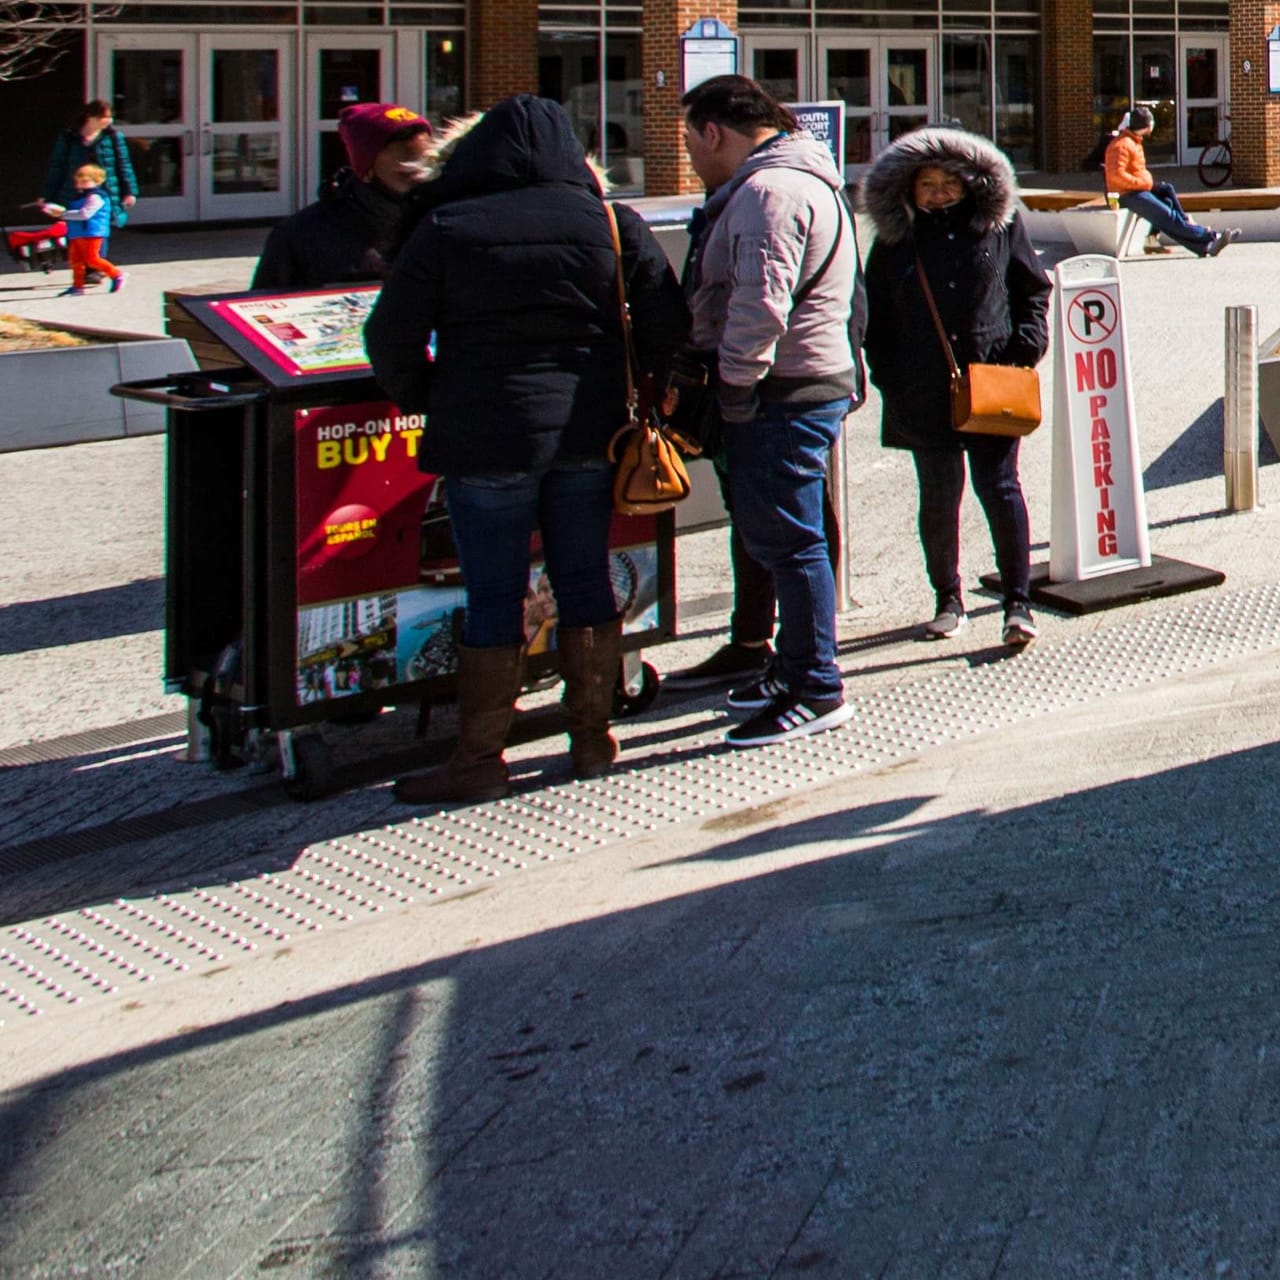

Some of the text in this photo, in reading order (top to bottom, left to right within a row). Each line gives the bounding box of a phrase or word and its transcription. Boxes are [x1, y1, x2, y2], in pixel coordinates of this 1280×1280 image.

[795, 111, 829, 122] YOUTH
[1075, 347, 1118, 393] NO
[317, 418, 391, 441] HOP-ON
[317, 432, 393, 470] BUY
[1089, 395, 1119, 557] PARKING
